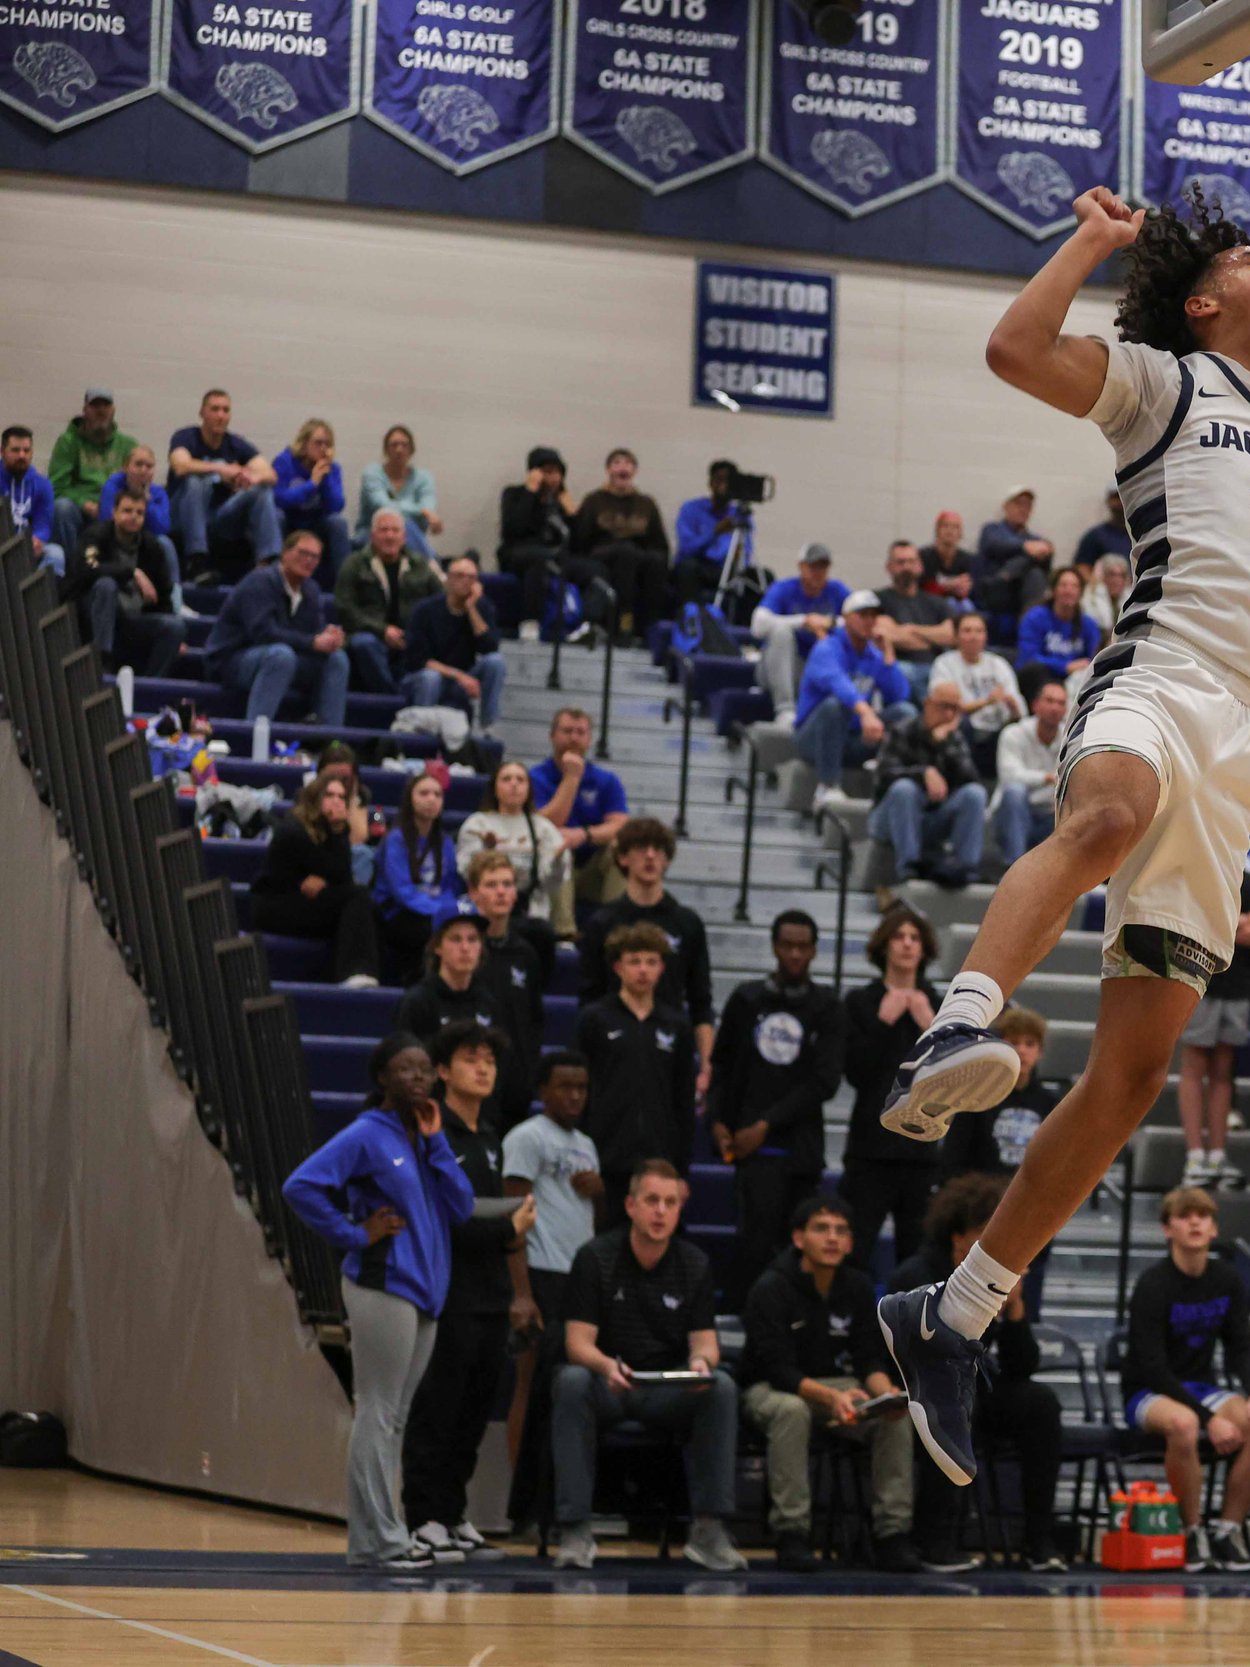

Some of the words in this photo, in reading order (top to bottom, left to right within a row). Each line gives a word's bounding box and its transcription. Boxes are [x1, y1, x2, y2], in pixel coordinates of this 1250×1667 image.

[212, 3, 241, 25] 5A
[244, 7, 313, 32] STATE
[416, 0, 466, 20] GIRLS
[467, 5, 515, 24] GOLF
[981, 0, 1100, 31] JAGUARS
[196, 24, 328, 57] CHAMPIONS
[413, 25, 443, 47] 6A
[446, 29, 514, 55] STATE
[586, 17, 626, 38] GIRLS
[627, 24, 673, 44] CROSS
[674, 29, 740, 50] COUNTRY
[998, 29, 1084, 70] 2019
[398, 48, 528, 80] CHAMPIONS
[613, 48, 642, 69] 6A
[644, 52, 710, 77] STATE
[598, 69, 725, 102] CHAMPIONS
[806, 72, 835, 93] 6A
[837, 75, 902, 100] STATE
[998, 69, 1082, 96] FOOTBALL
[791, 93, 917, 126] CHAMPIONS
[993, 95, 1021, 117] 5A
[1022, 99, 1088, 125] STATE
[978, 116, 1102, 149] CHAMPIONS
[1177, 117, 1205, 139] 6A
[707, 273, 829, 315] VISITOR
[705, 317, 827, 359] STUDENT
[704, 360, 826, 403] SEATING
